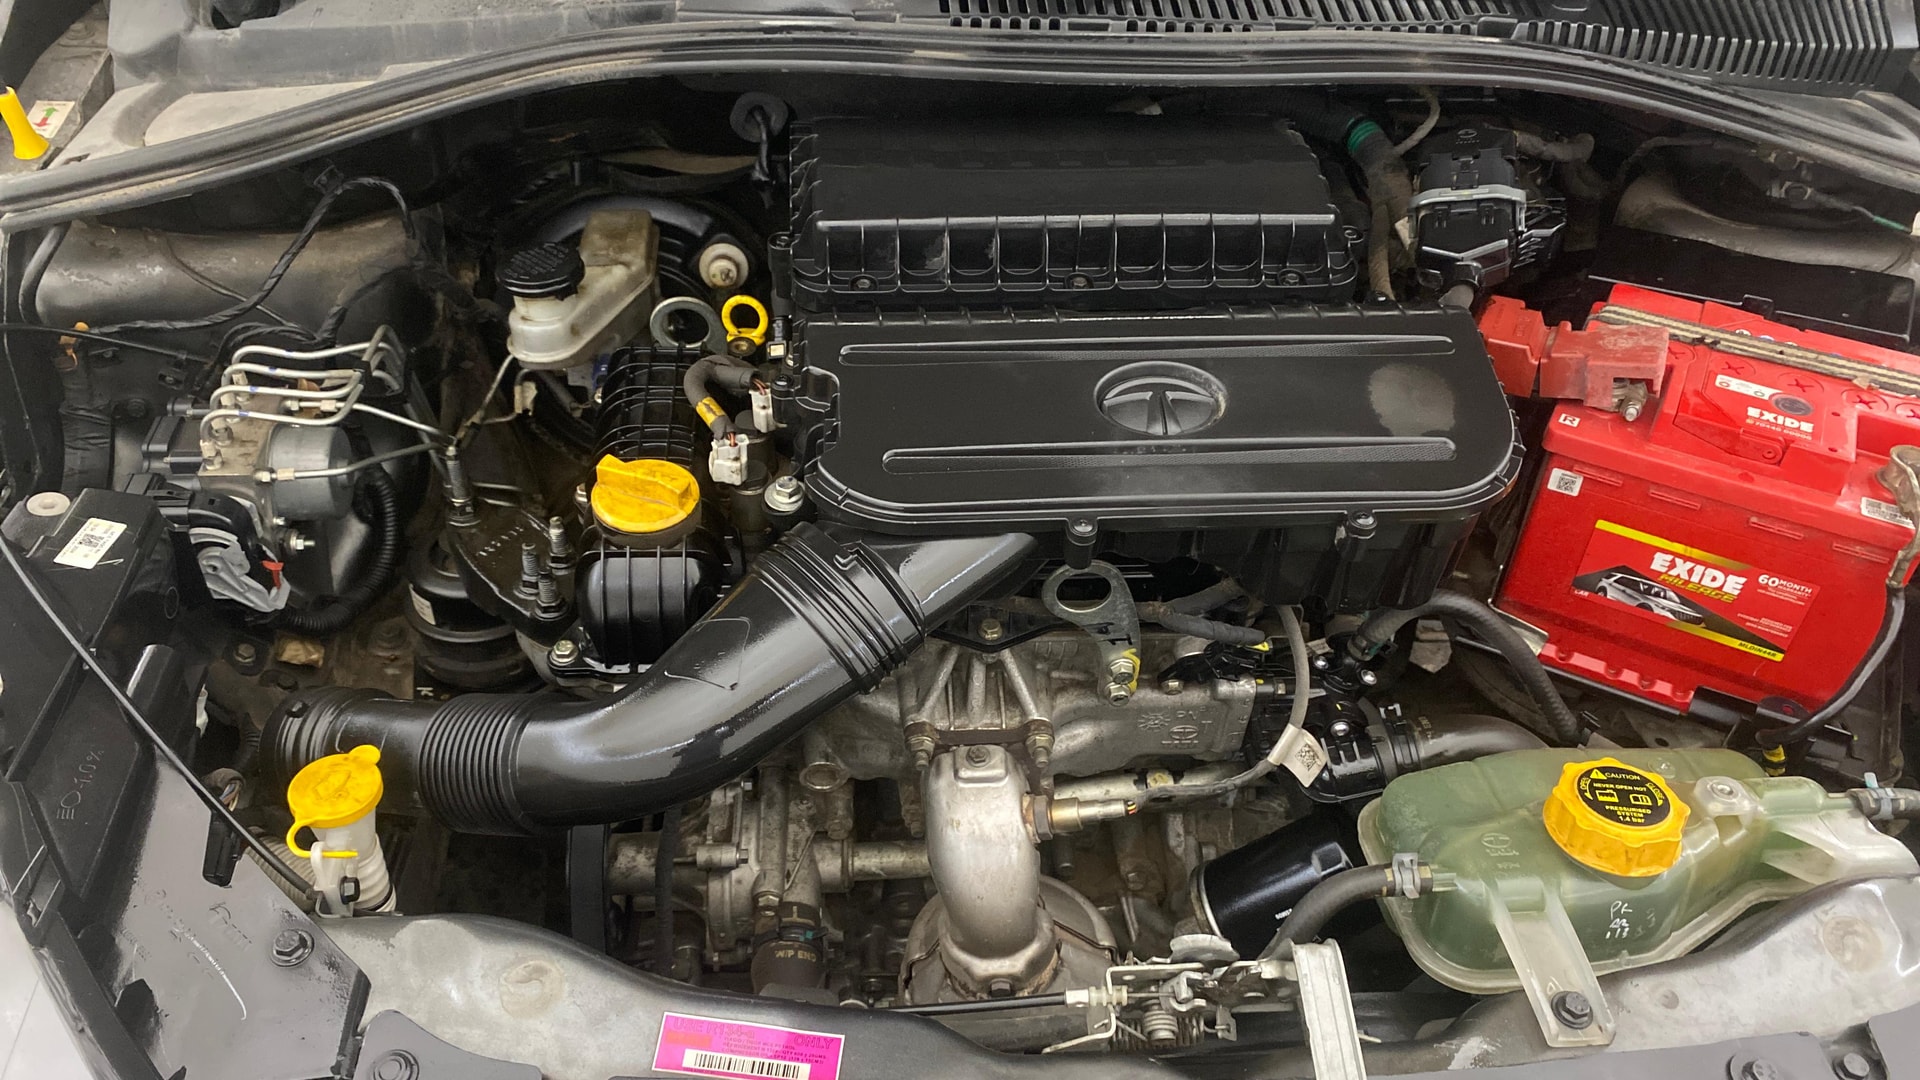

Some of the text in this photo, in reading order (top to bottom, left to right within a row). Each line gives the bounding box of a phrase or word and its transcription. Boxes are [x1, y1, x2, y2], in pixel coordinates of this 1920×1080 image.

[1562, 415, 1576, 425] R
[1747, 406, 1814, 433] EXIDE
[1649, 552, 1748, 596] EXIDE
[1758, 574, 1812, 594] 60 MONTH
[1658, 573, 1738, 603] MILEAGE
[1604, 772, 1641, 781] CAUTION
[1605, 805, 1652, 815] PRESSURISED
[673, 1017, 704, 1033] USE
[793, 1034, 834, 1050] ONLY
